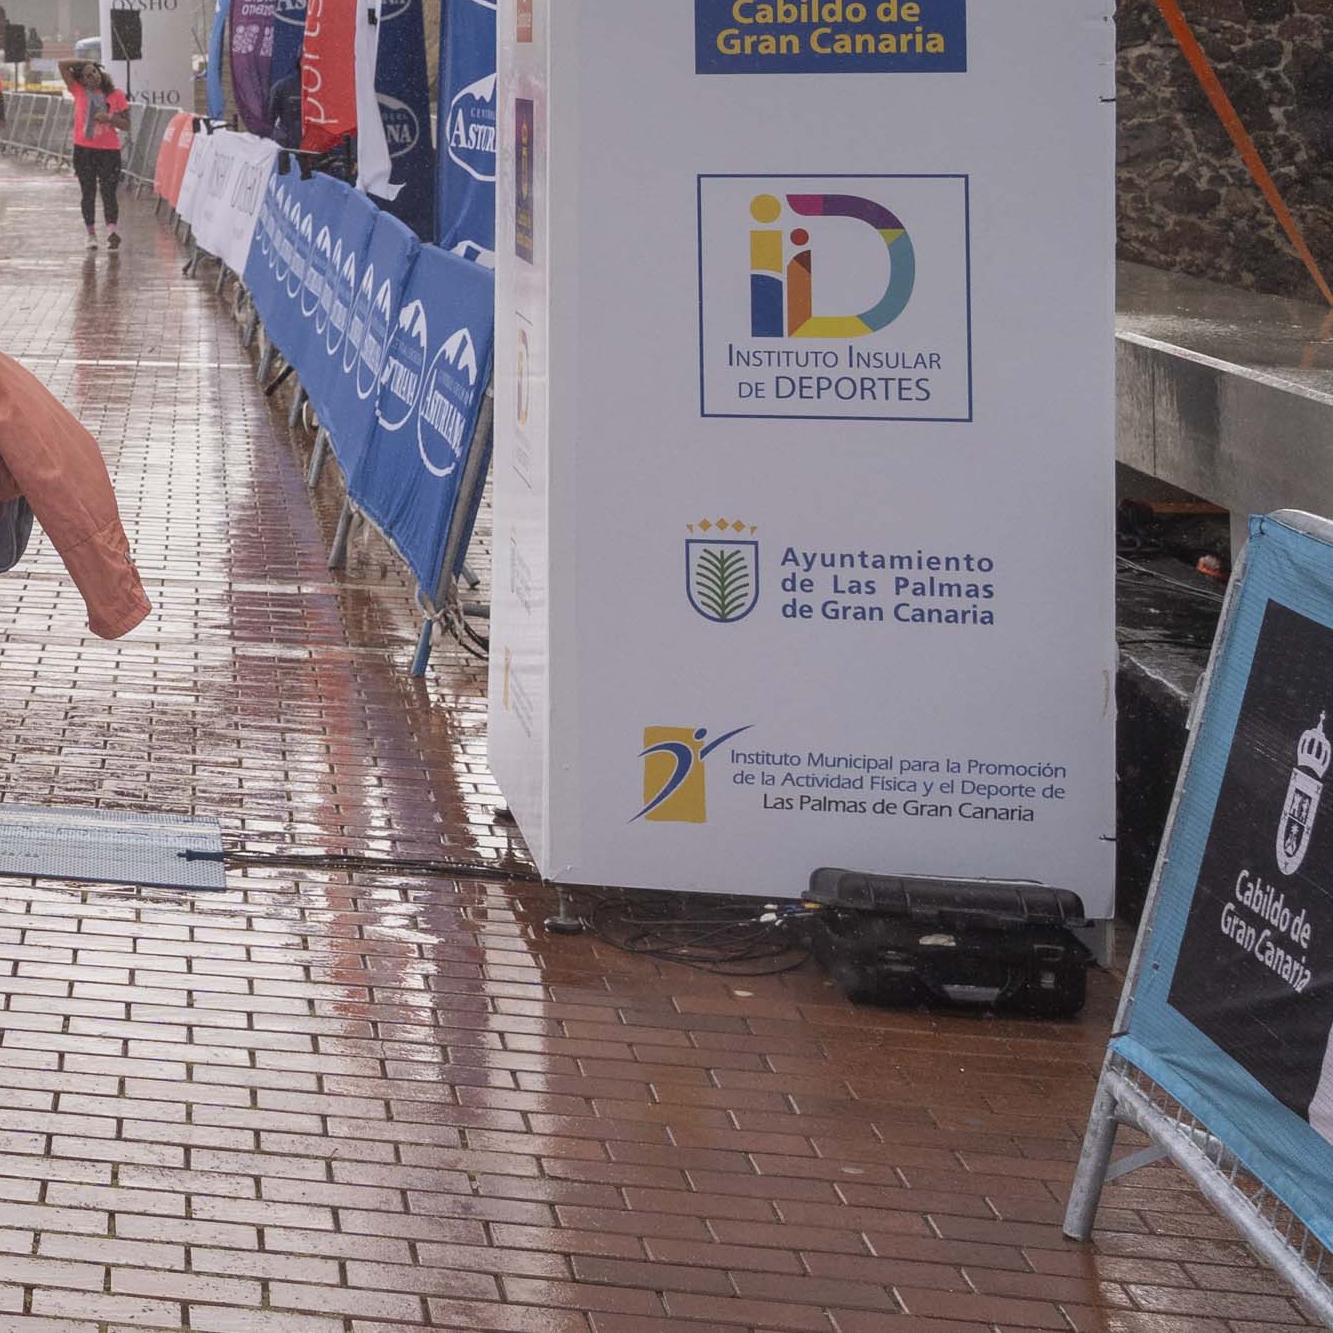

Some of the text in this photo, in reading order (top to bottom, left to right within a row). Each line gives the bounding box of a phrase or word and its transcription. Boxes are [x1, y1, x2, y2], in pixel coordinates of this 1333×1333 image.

[716, 26, 945, 56] Gran Canaria
[728, 343, 942, 370] INSTITUTO INSULAR
[738, 375, 931, 402] DE DEPORTES
[781, 547, 994, 573] Ayuntamiento
[781, 572, 994, 599] de Las Palmas
[782, 597, 995, 625] de Gran Canaria
[731, 749, 1067, 778] Instituto Municipal para la Promoción
[732, 769, 1065, 800] de la Actividad Física y el Deporte de
[763, 793, 1034, 822] Las Palmas de Gran Canaria
[1235, 868, 1311, 949] Cabildo de
[1221, 902, 1312, 994] Gran Canaria
